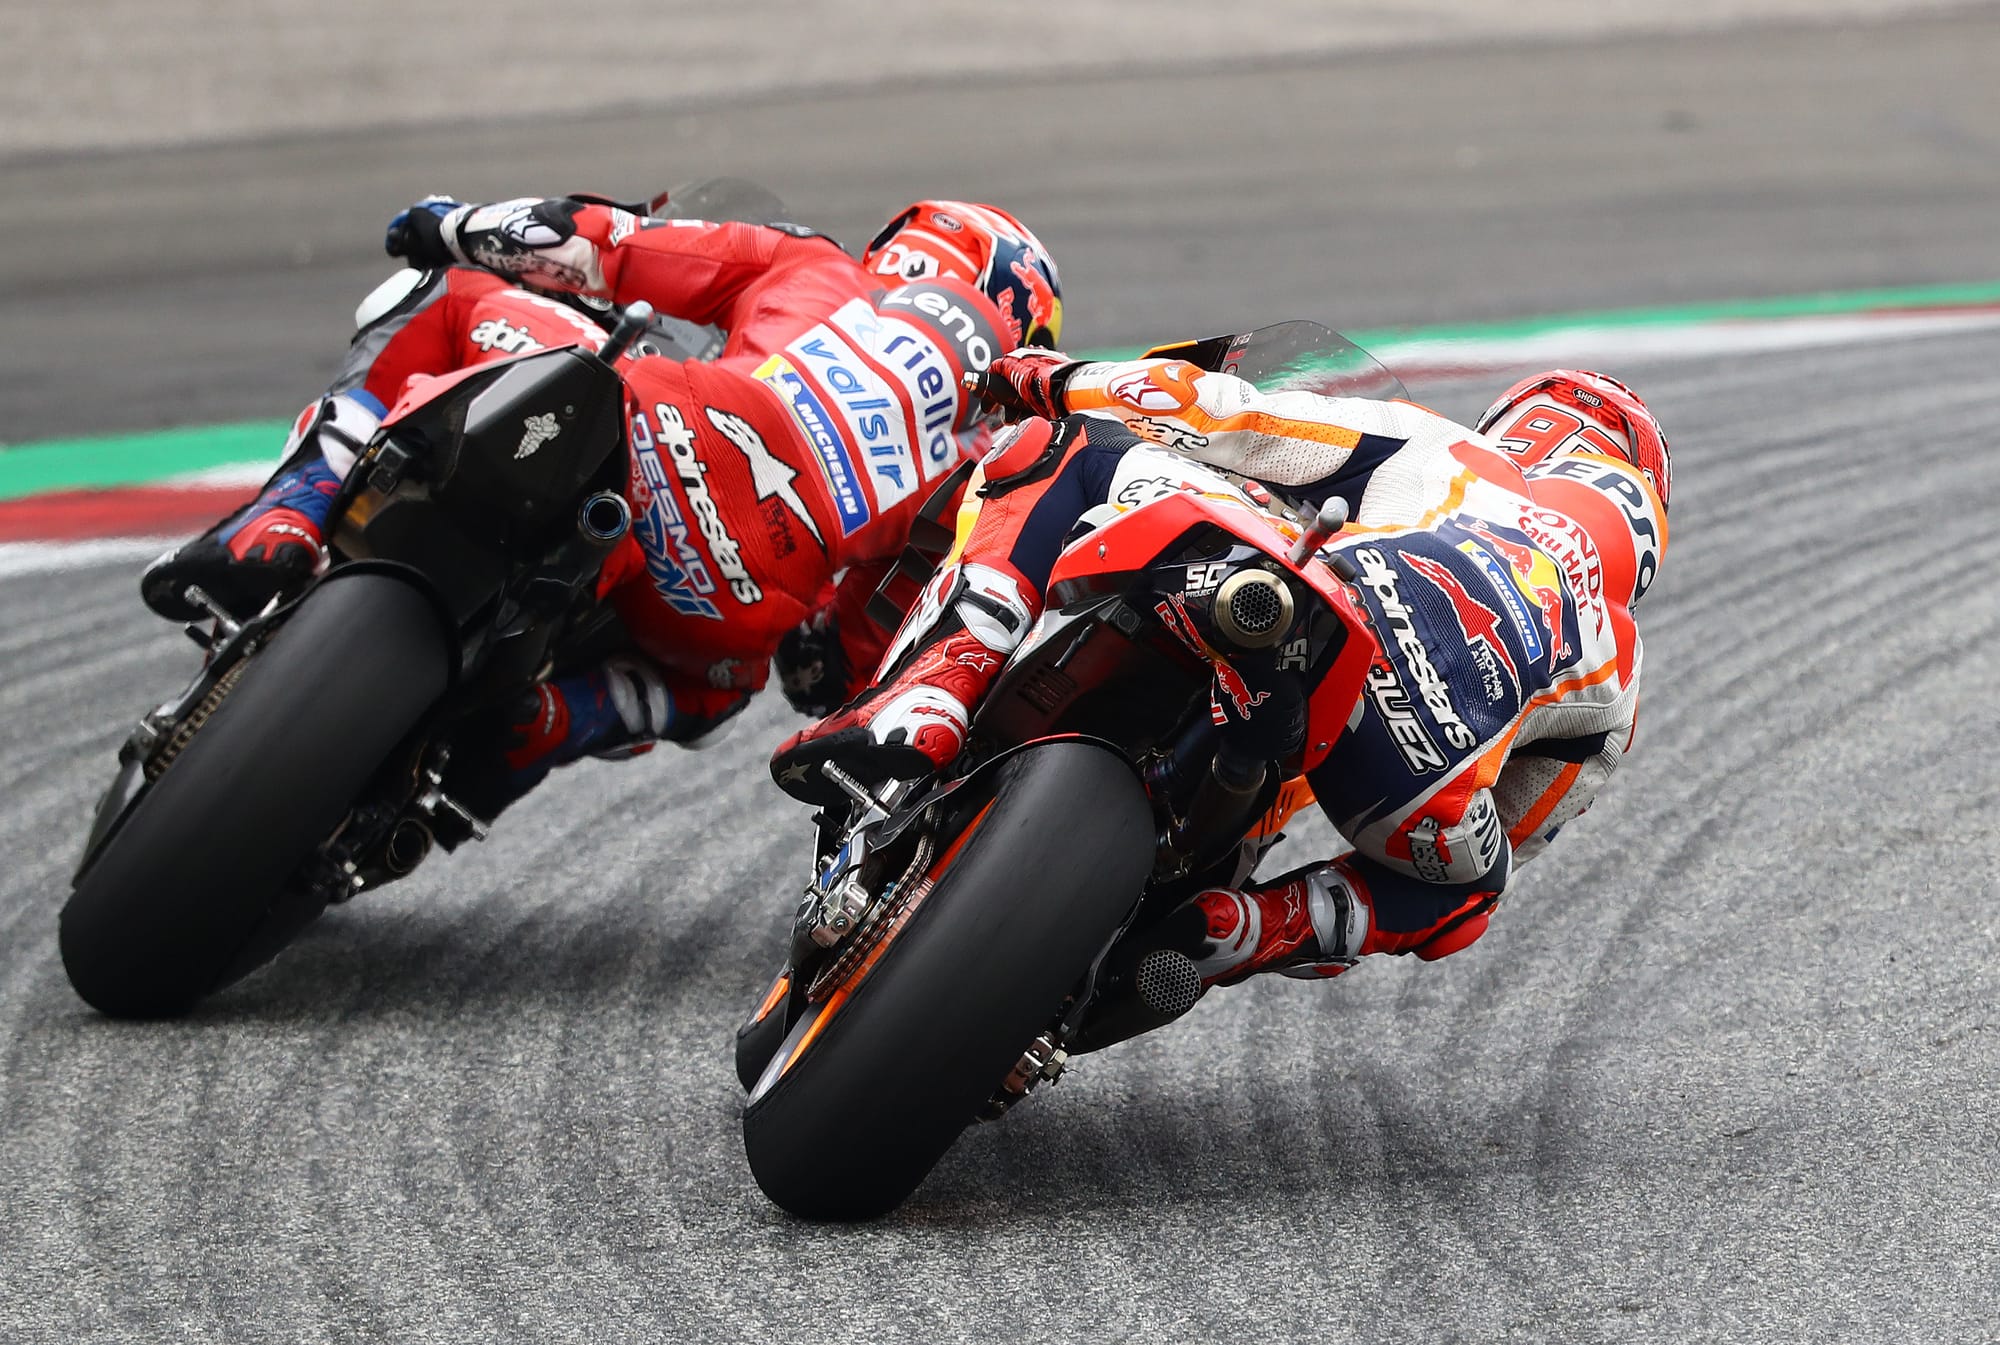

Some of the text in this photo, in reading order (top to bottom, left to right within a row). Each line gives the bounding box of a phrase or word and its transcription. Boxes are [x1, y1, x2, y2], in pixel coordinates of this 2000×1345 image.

[882, 286, 992, 373] Leno
[800, 338, 904, 490] valsir
[884, 334, 953, 463] riello
[1575, 389, 1601, 407] SHOEI
[631, 412, 716, 595] DESMO
[655, 403, 763, 605] alpinestars
[796, 402, 860, 516] MICHELIN
[1185, 588, 1217, 599] PROJECT
[1186, 563, 1227, 591] SC
[1489, 570, 1536, 648] MICHELIN
[1517, 504, 1604, 641] ONDA
[1354, 547, 1477, 749] alpinestars
